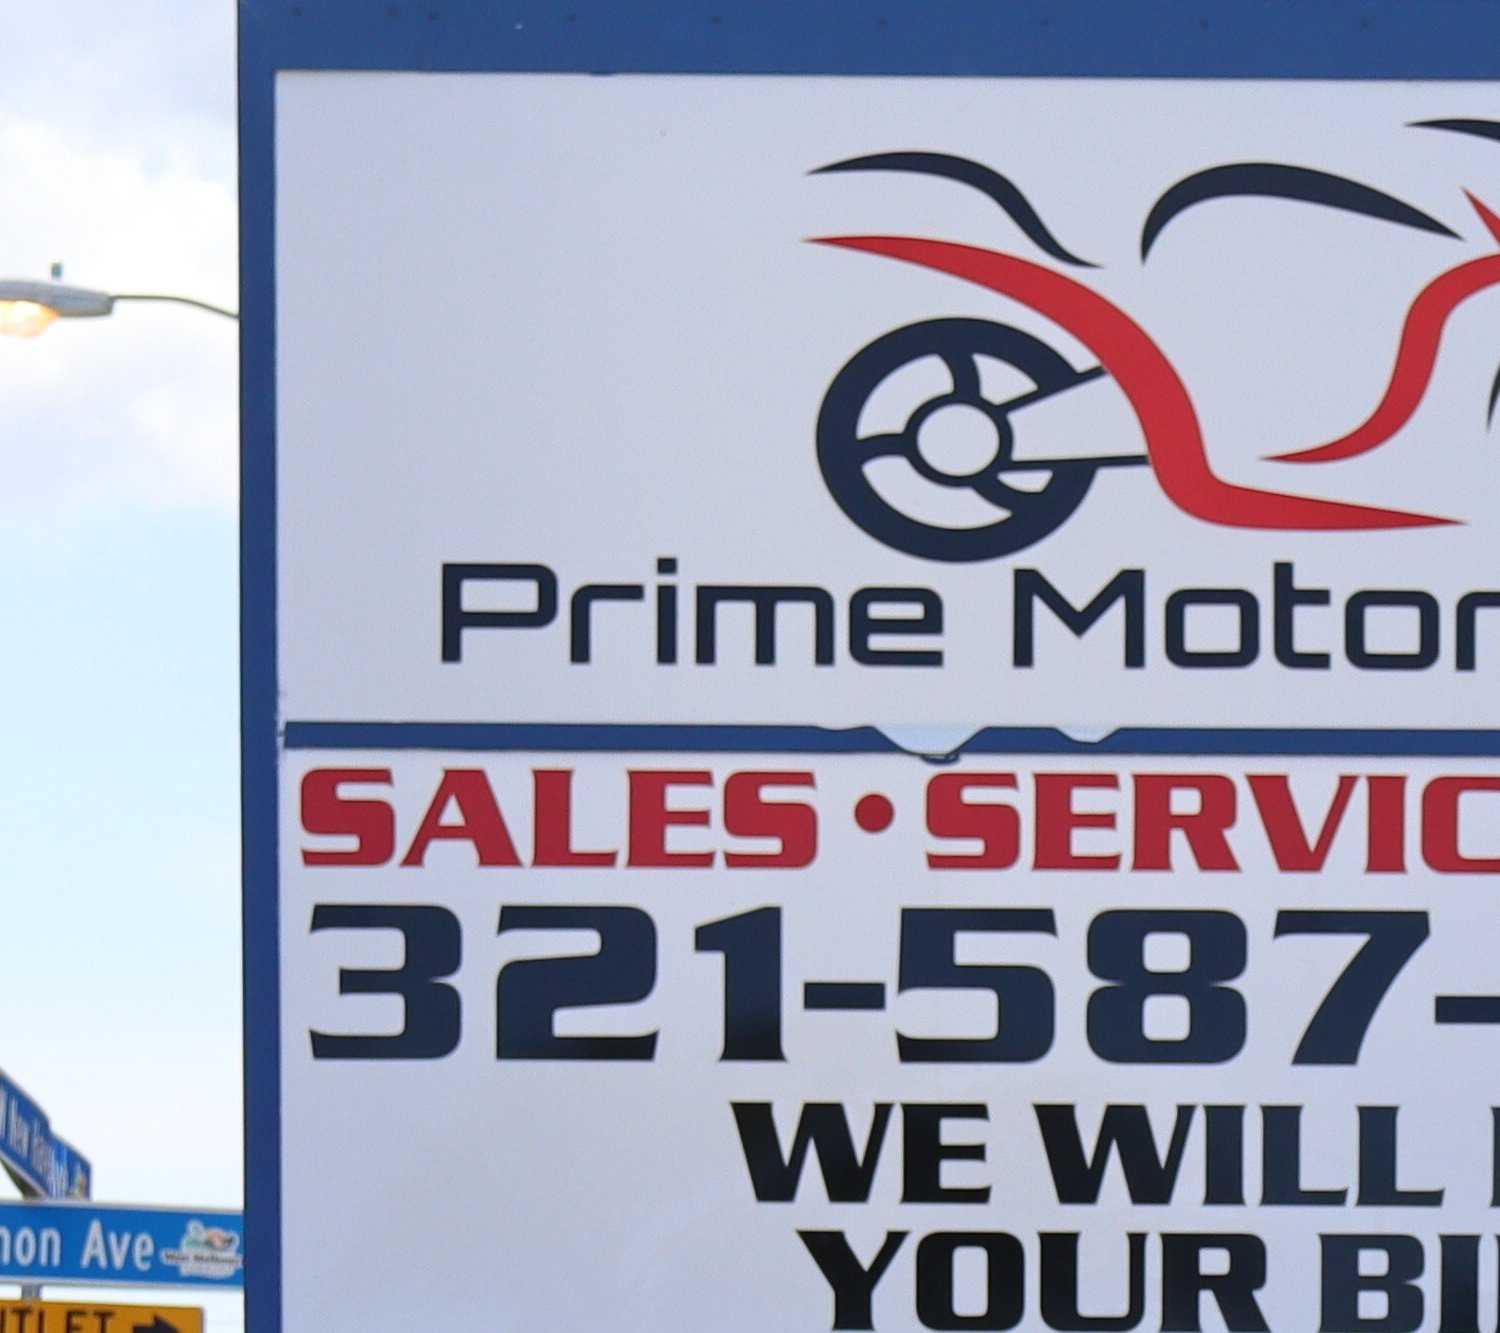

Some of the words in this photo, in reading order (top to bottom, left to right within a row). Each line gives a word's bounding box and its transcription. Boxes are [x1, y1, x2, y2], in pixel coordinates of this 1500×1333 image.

[442, 558, 944, 667] Prime
[301, 768, 817, 869] SALES
[729, 1101, 992, 1205] WE
[1032, 1103, 1445, 1208] WILL
[80, 1219, 155, 1272] Ave
